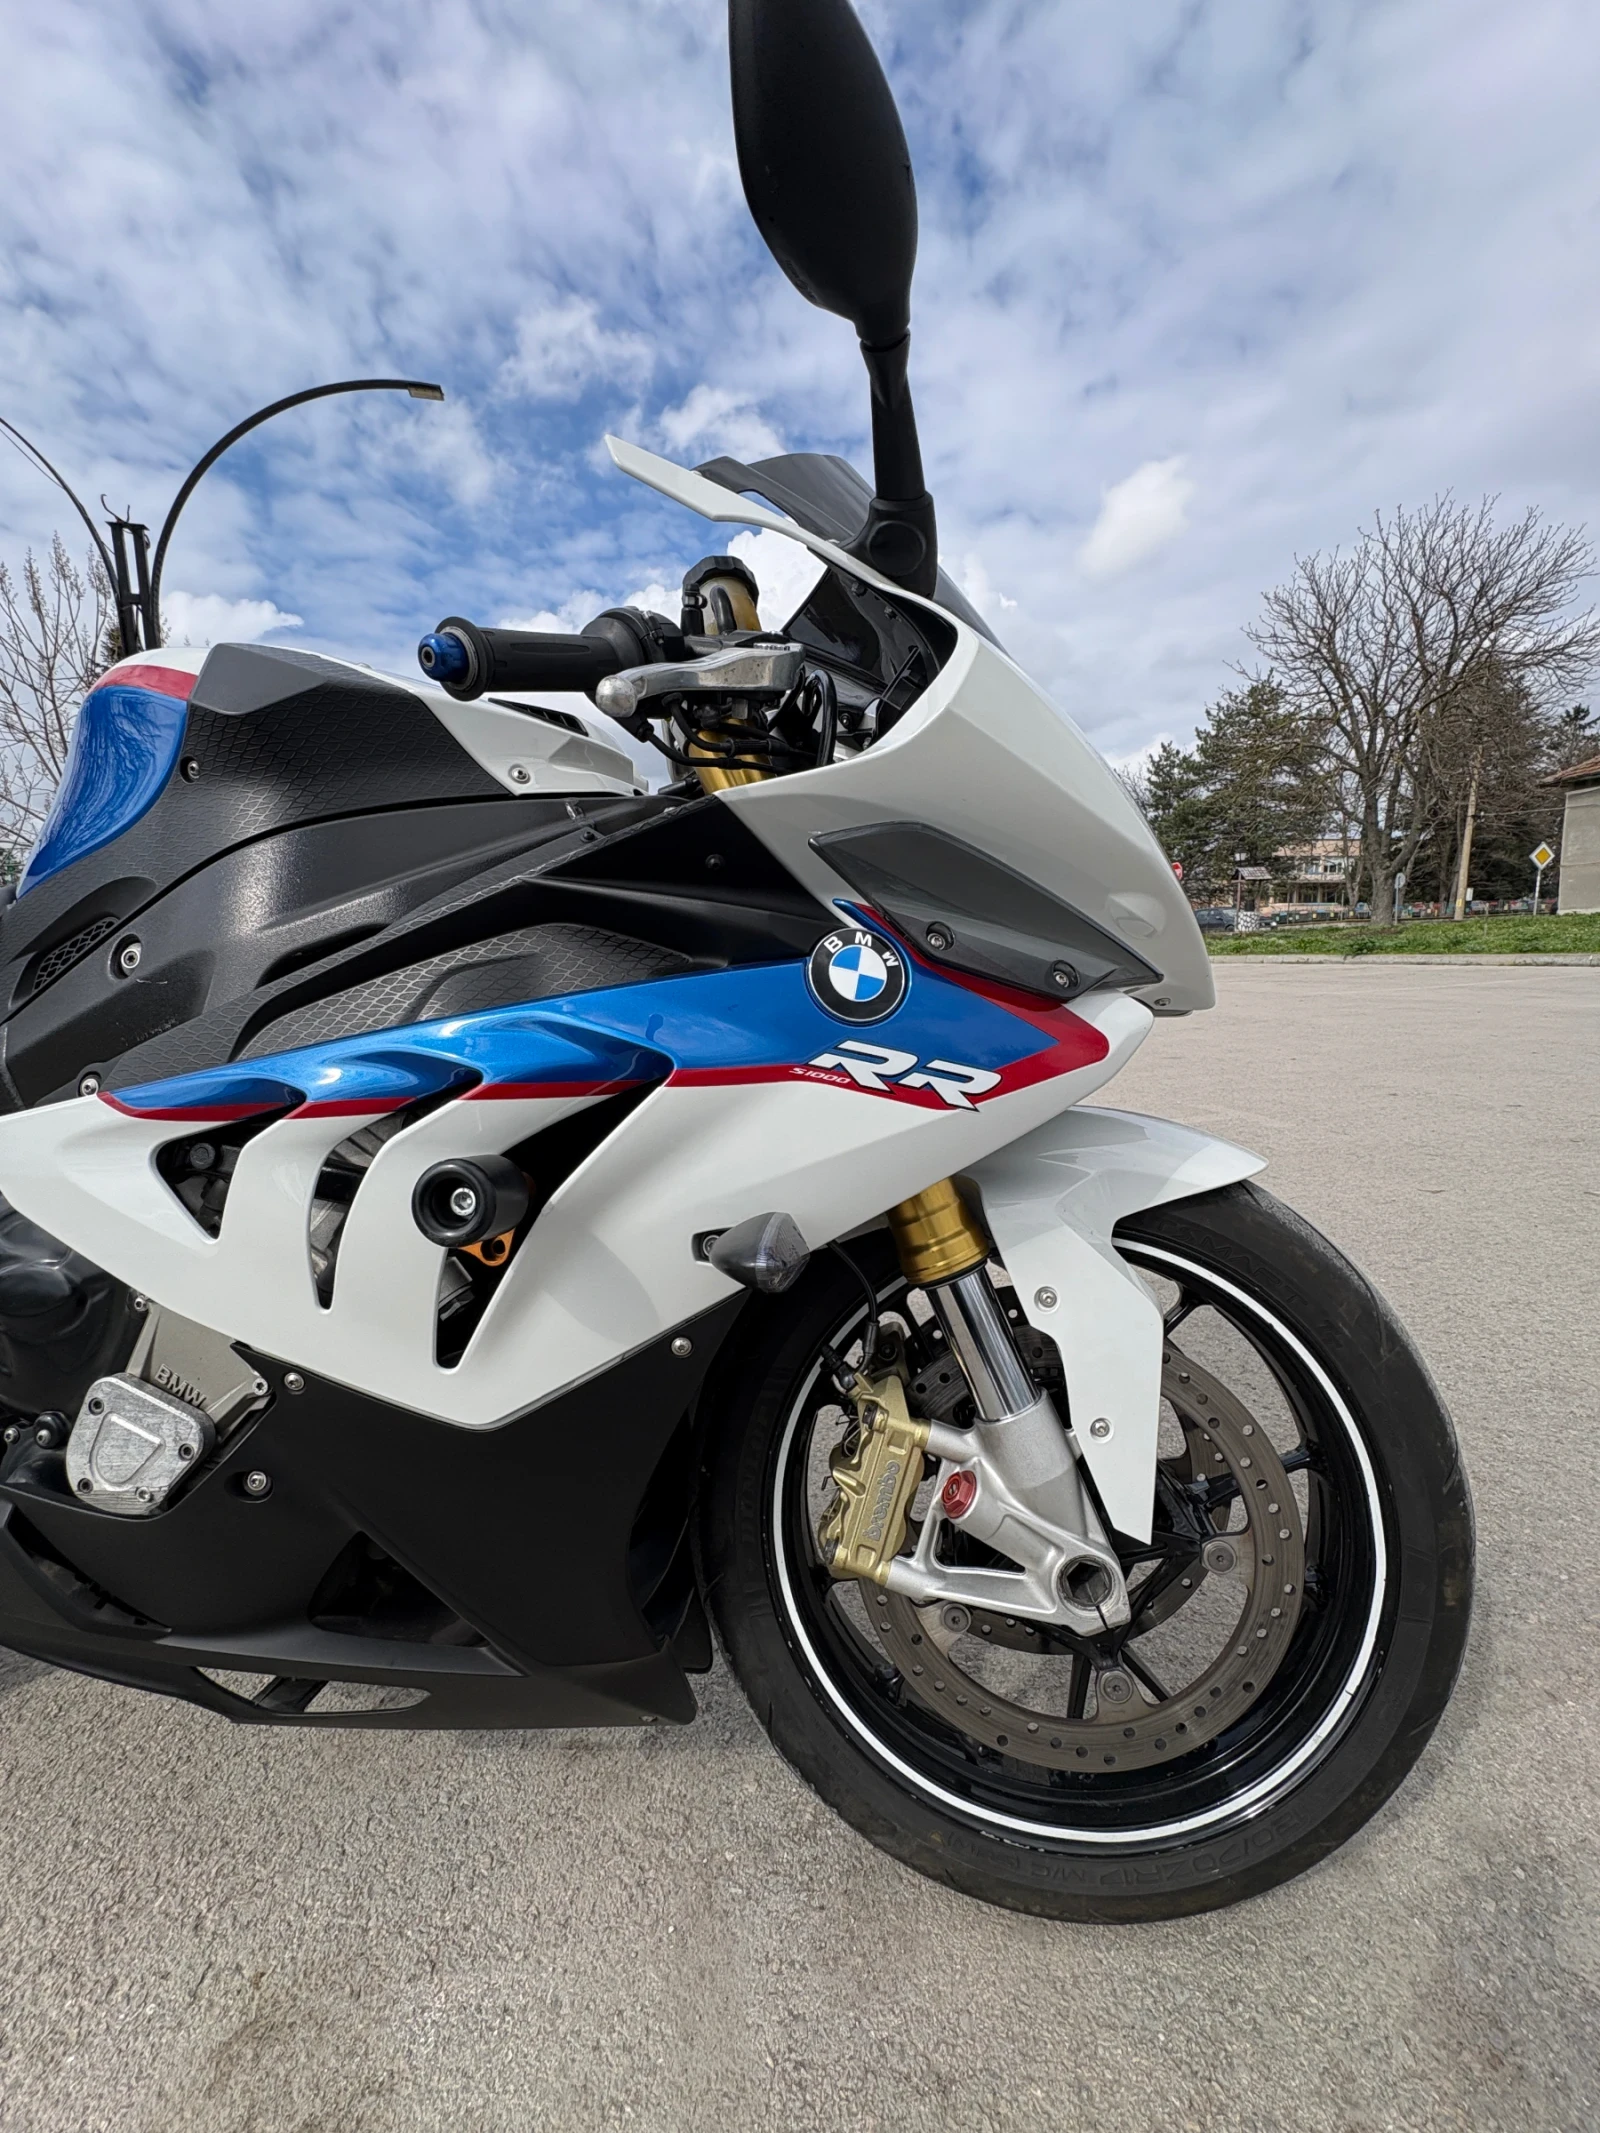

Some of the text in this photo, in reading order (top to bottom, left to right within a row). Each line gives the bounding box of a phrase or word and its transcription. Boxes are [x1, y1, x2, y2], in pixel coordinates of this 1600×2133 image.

[823, 931, 900, 968] BMW
[788, 1066, 851, 1084] S1000
[807, 1039, 1002, 1112] RR
[154, 1363, 207, 1407] BMW
[861, 1460, 901, 1542] brembo
